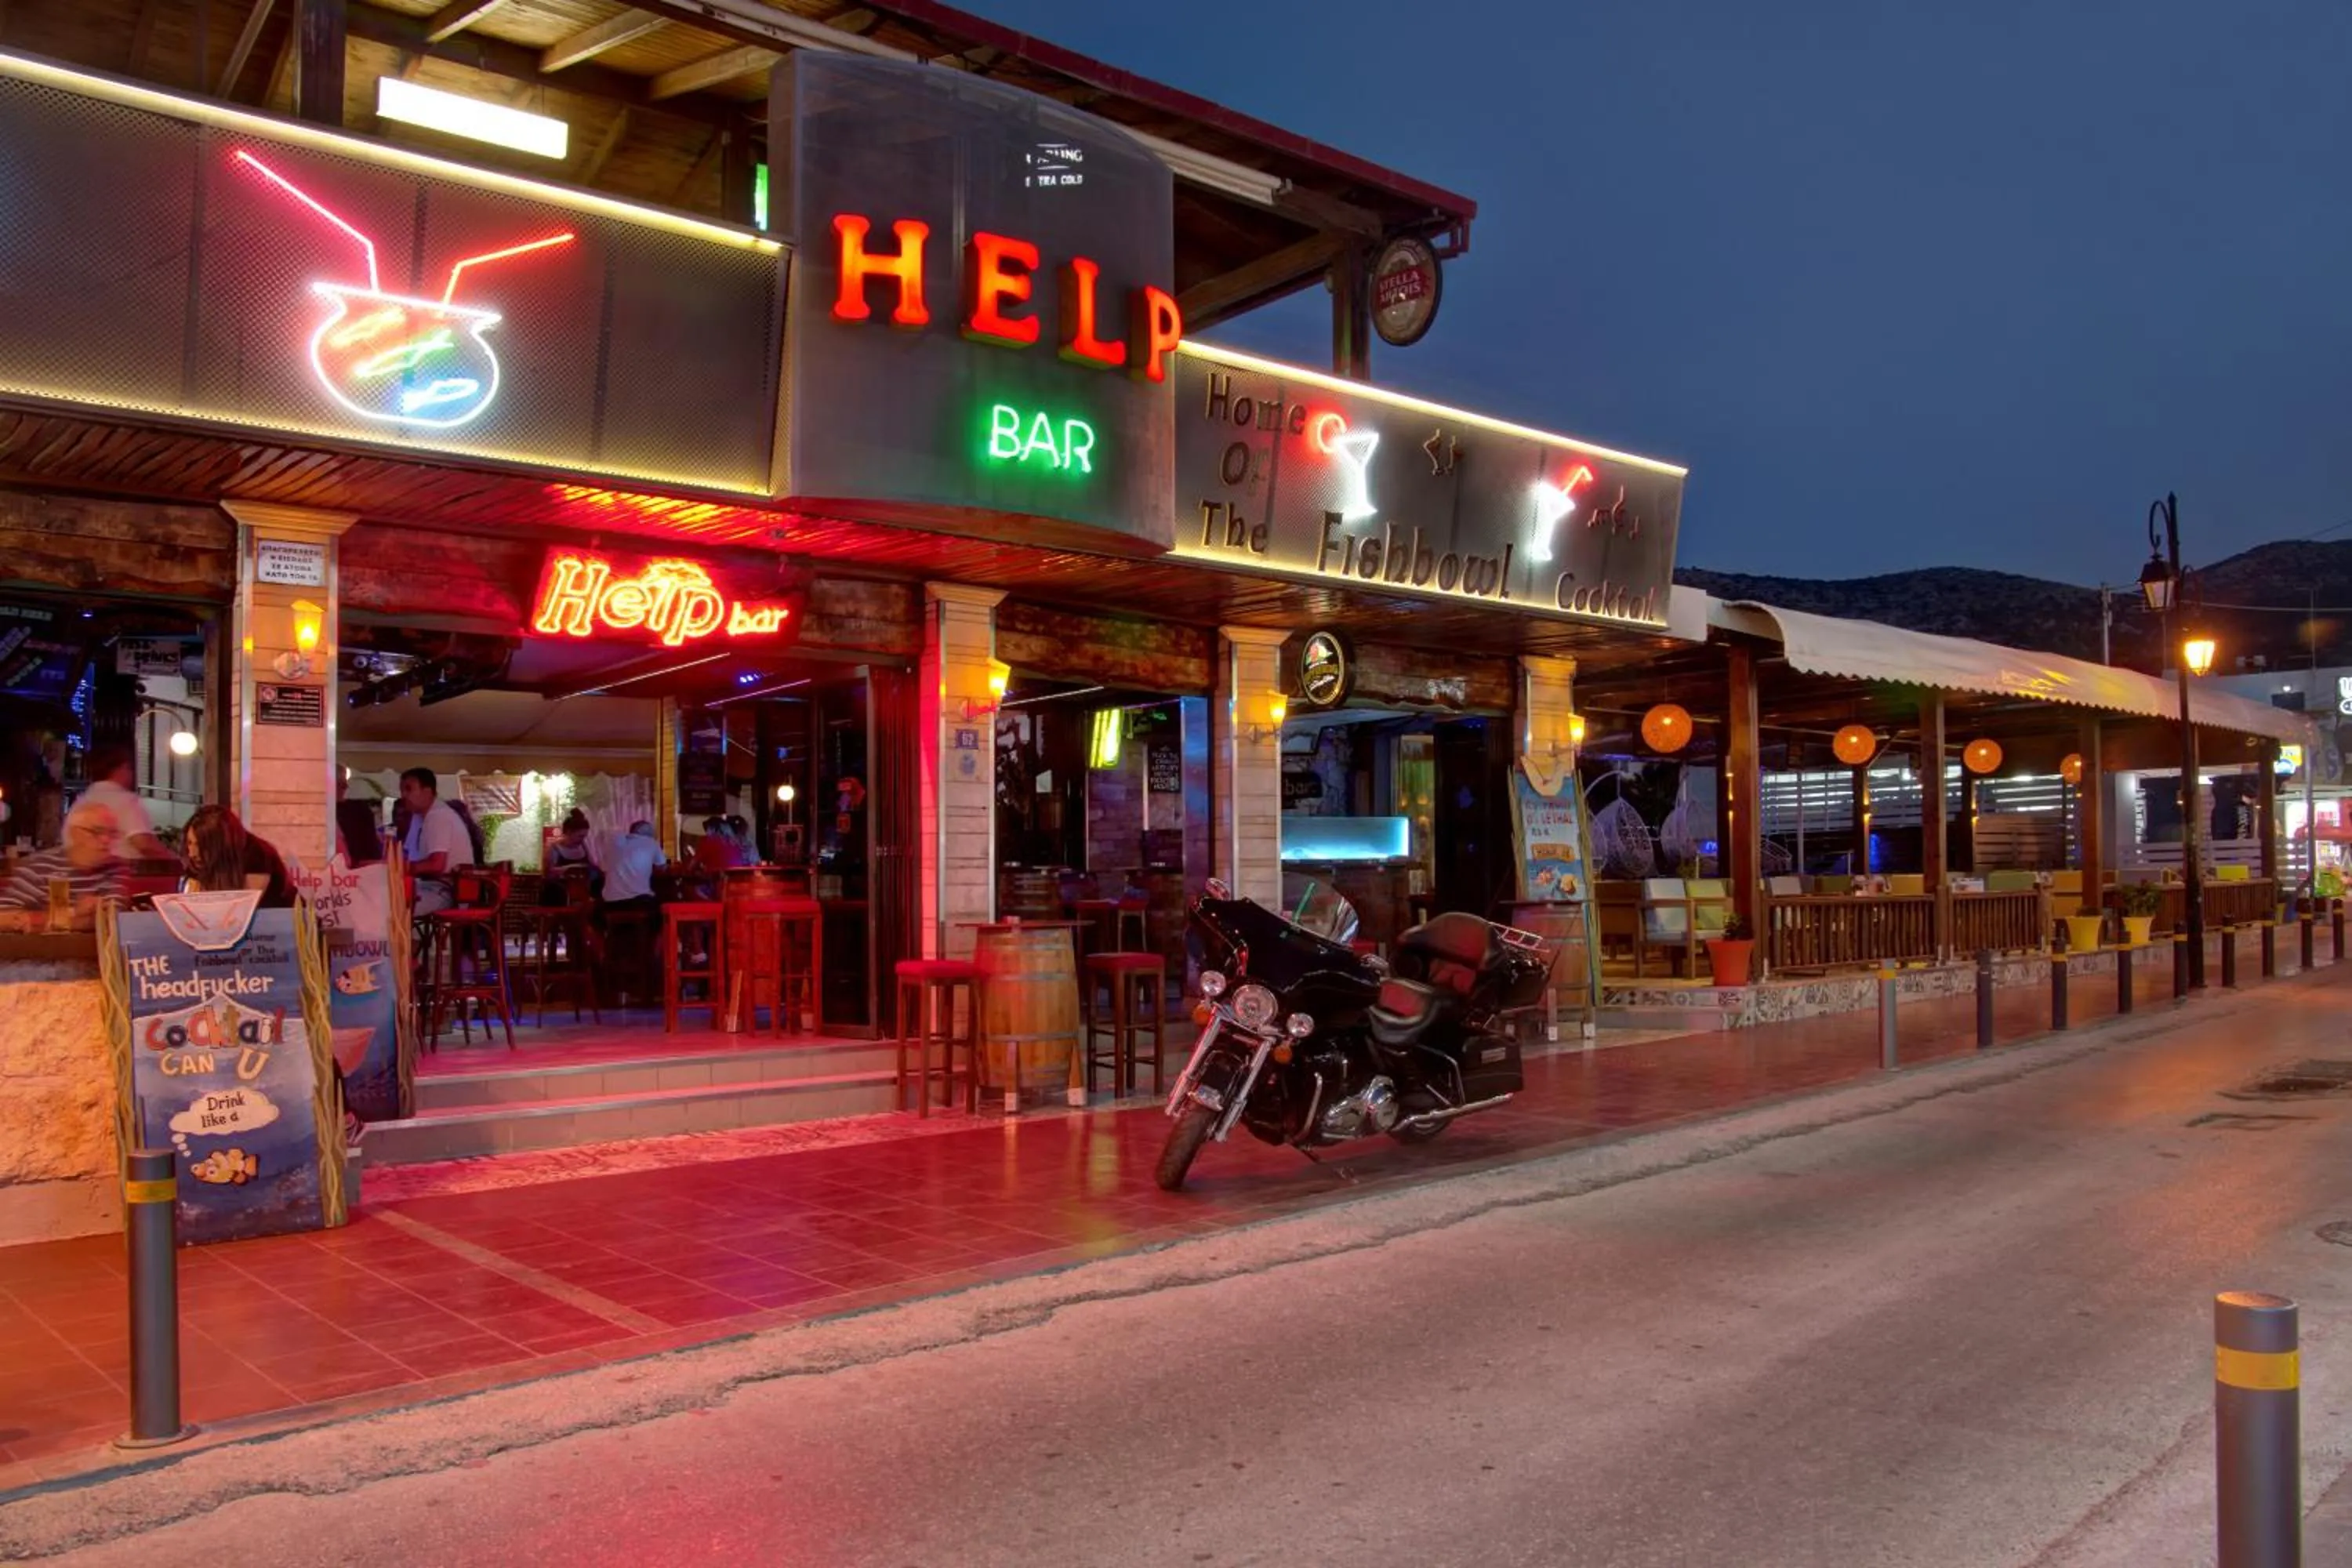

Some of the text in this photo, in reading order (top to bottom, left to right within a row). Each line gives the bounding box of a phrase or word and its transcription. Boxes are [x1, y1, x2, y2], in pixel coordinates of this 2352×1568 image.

[831, 213, 1182, 385] HELP
[1205, 372, 1307, 436] Home
[989, 403, 1095, 474] BAR
[1200, 499, 1655, 622] The Fishbowl Cocktail
[535, 557, 788, 646] Help bar
[289, 864, 360, 892] Help bar
[315, 889, 352, 910] orlds
[129, 955, 172, 978] THE
[161, 1047, 270, 1080] CAN U
[207, 1091, 245, 1111] Drink
[201, 1111, 238, 1128] like a
